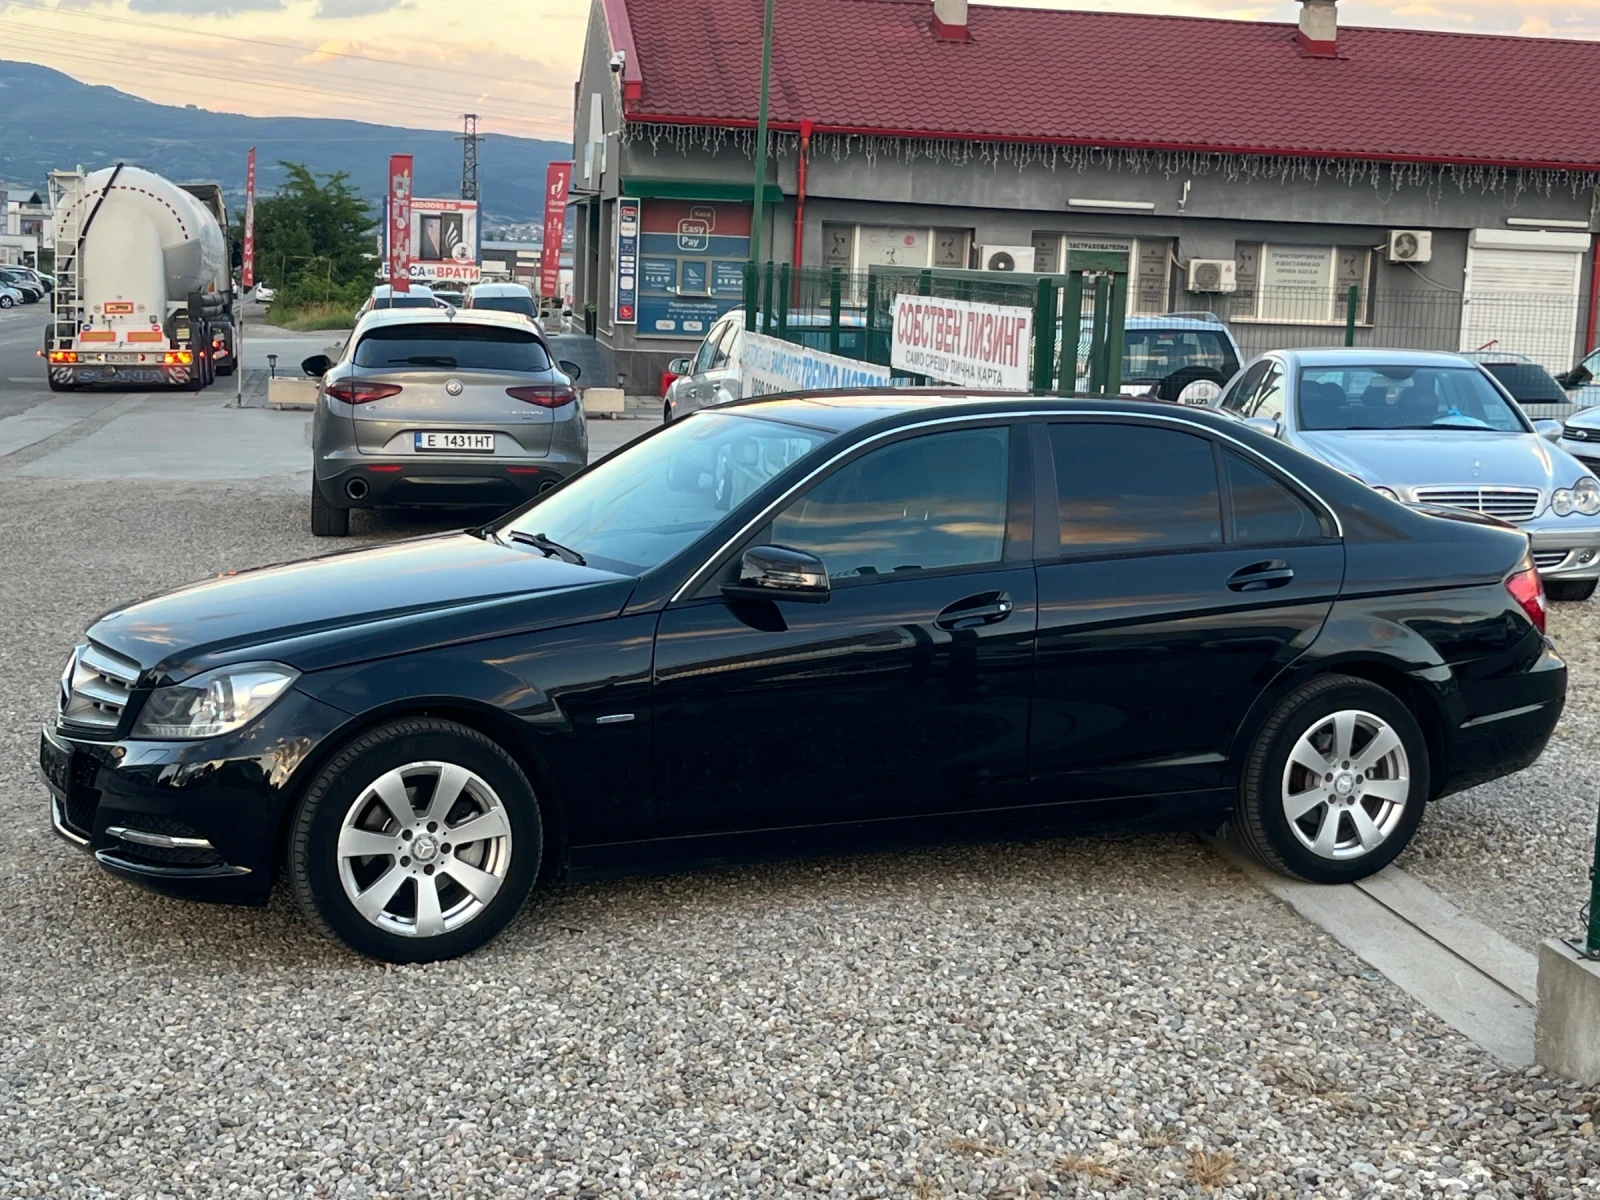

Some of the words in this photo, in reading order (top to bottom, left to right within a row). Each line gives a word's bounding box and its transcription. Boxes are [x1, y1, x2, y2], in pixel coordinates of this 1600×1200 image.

[410, 201, 456, 210] ARDOORS.BG
[682, 223, 705, 235] Easy
[681, 236, 699, 247] Pay
[1068, 242, 1129, 251] ЗАСТРАХОВАТЕЛНА
[384, 265, 426, 277] БСА
[436, 266, 479, 280] ВРАТИ
[897, 302, 963, 356] СОБСТВЕН
[963, 311, 1026, 367] ЛИЗИНГ
[802, 356, 839, 389] TRENDO
[905, 350, 925, 366] САМО
[949, 359, 975, 381] ЛИЧНА
[977, 366, 1003, 387] КАРТА
[76, 369, 166, 383] SCANIA
[444, 434, 472, 448] 1431
